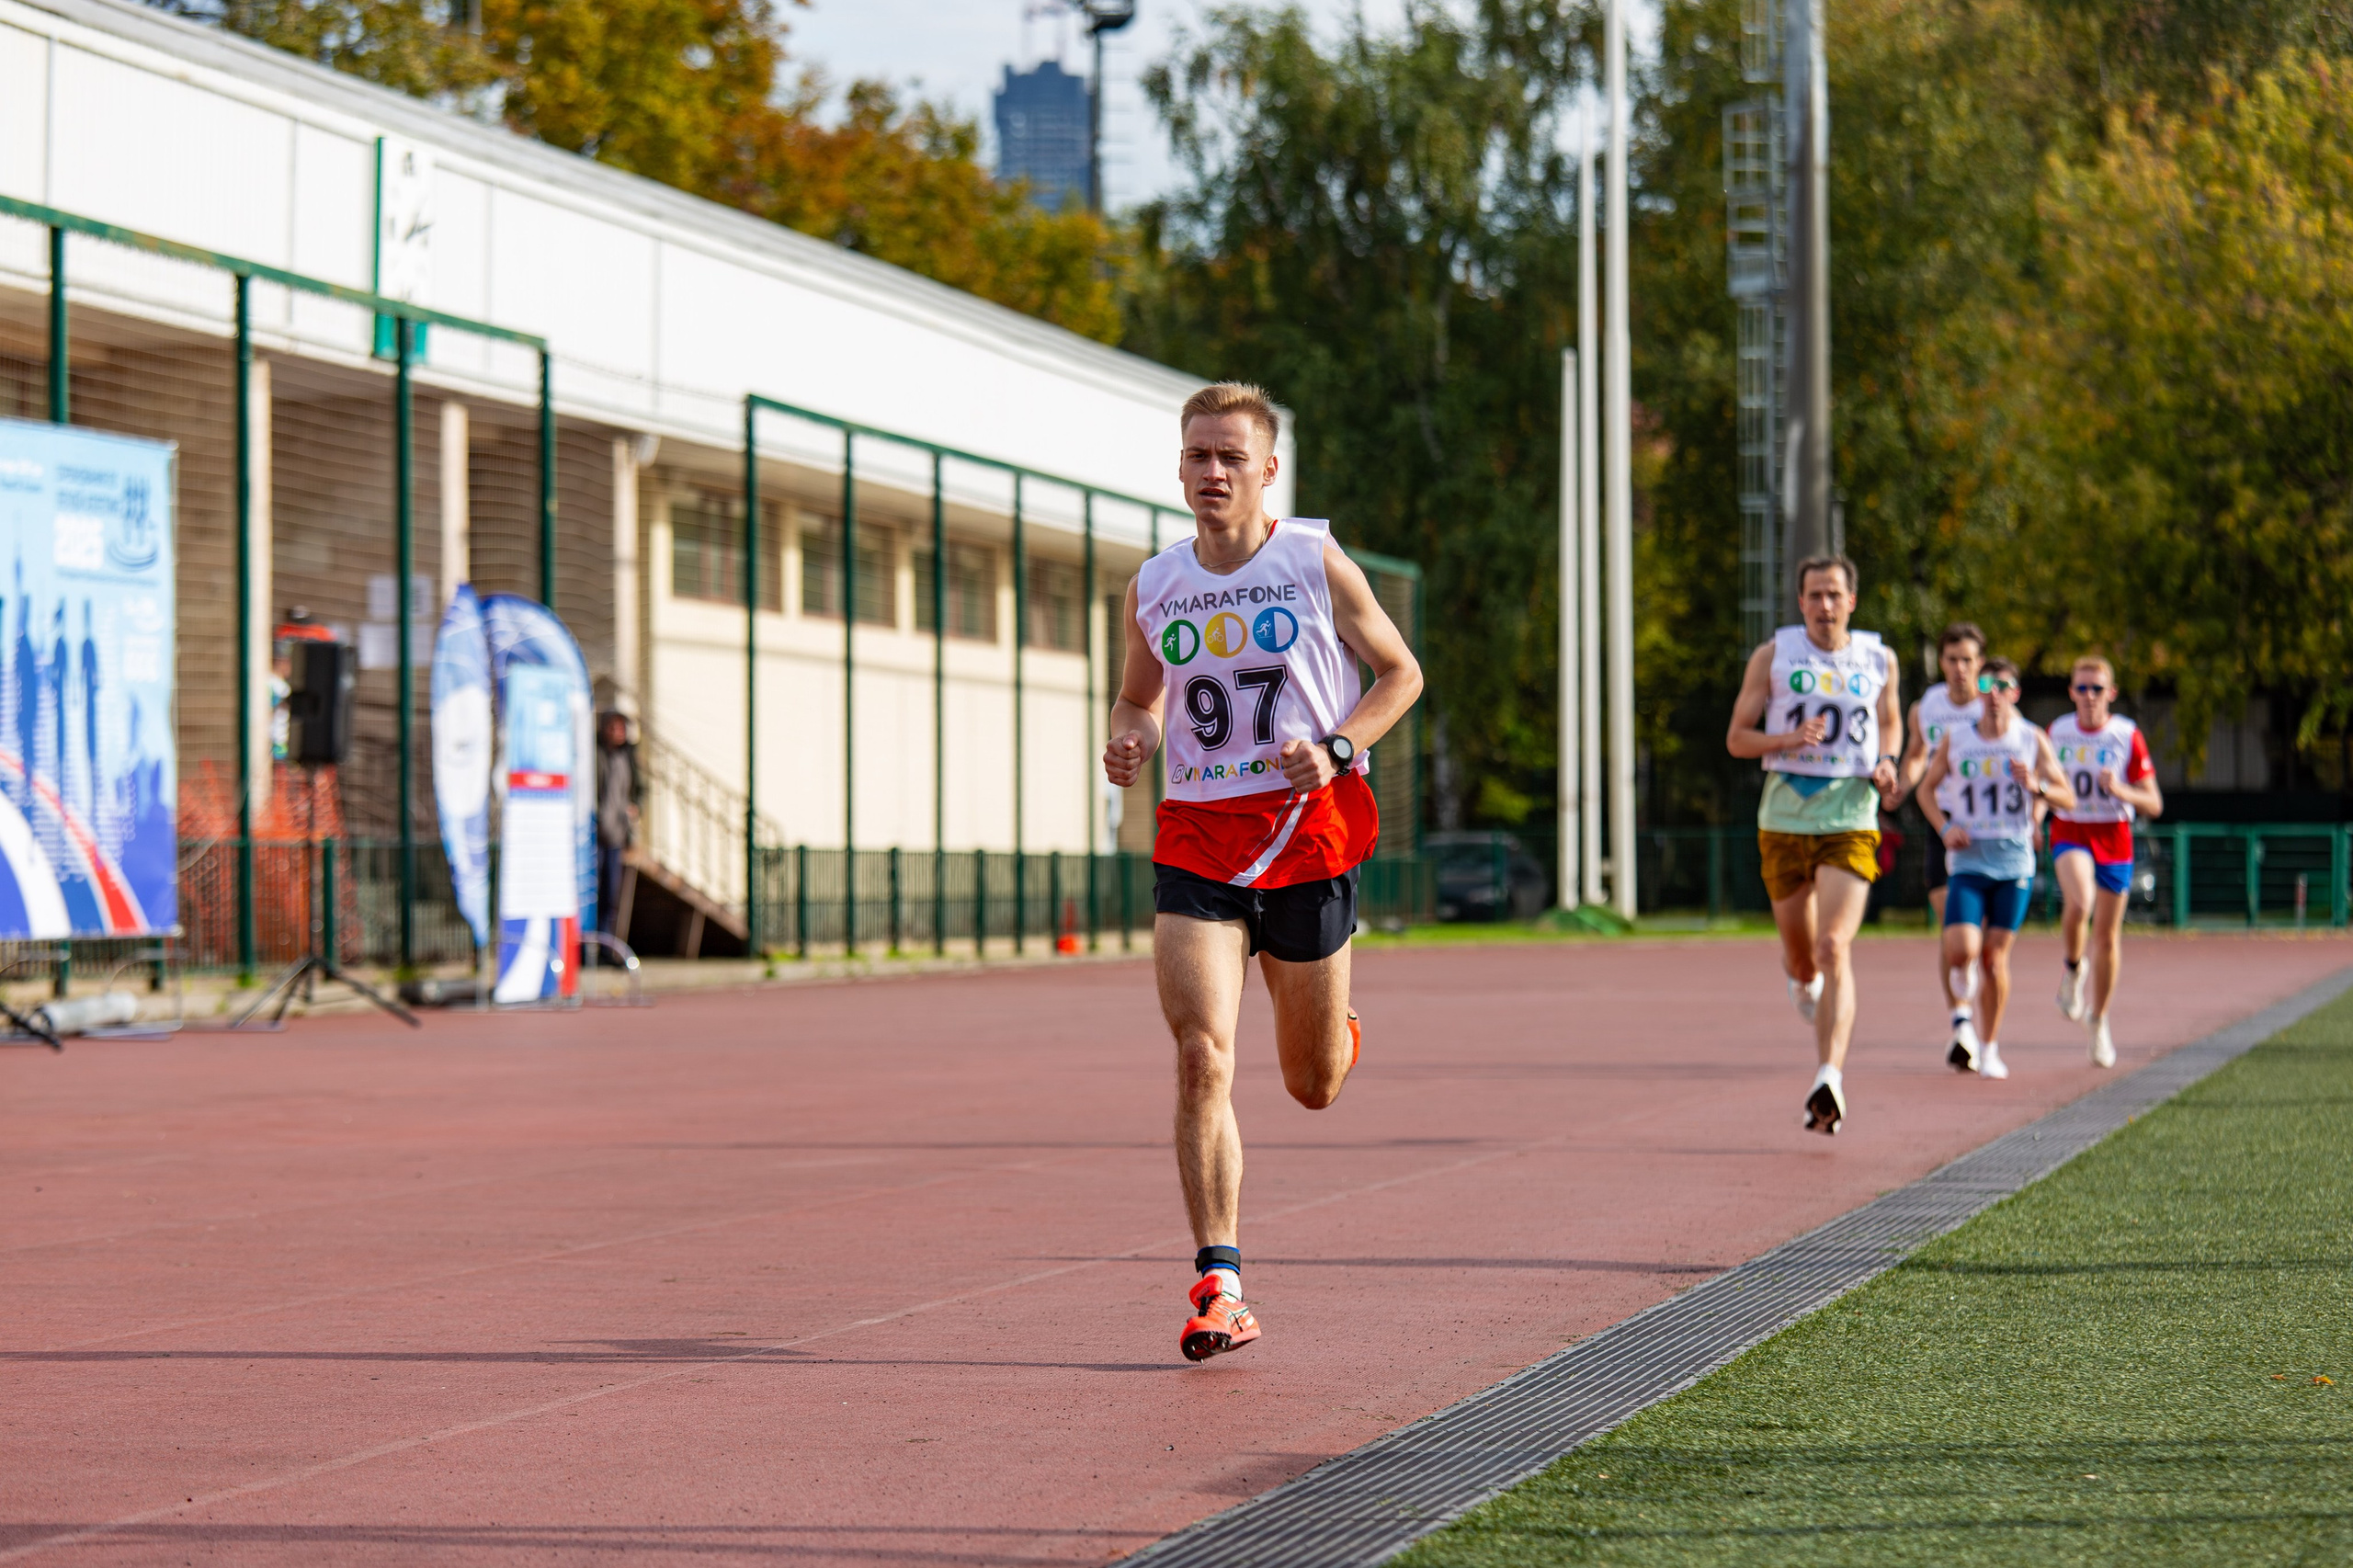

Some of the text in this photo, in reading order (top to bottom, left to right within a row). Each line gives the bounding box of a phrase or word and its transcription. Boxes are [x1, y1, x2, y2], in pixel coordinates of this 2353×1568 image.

[1159, 584, 1297, 618] VMARAFONE
[1184, 664, 1289, 752] 97
[1786, 702, 1869, 749] 103
[1185, 756, 1285, 782] VMARAFON
[1960, 782, 2023, 816] 113
